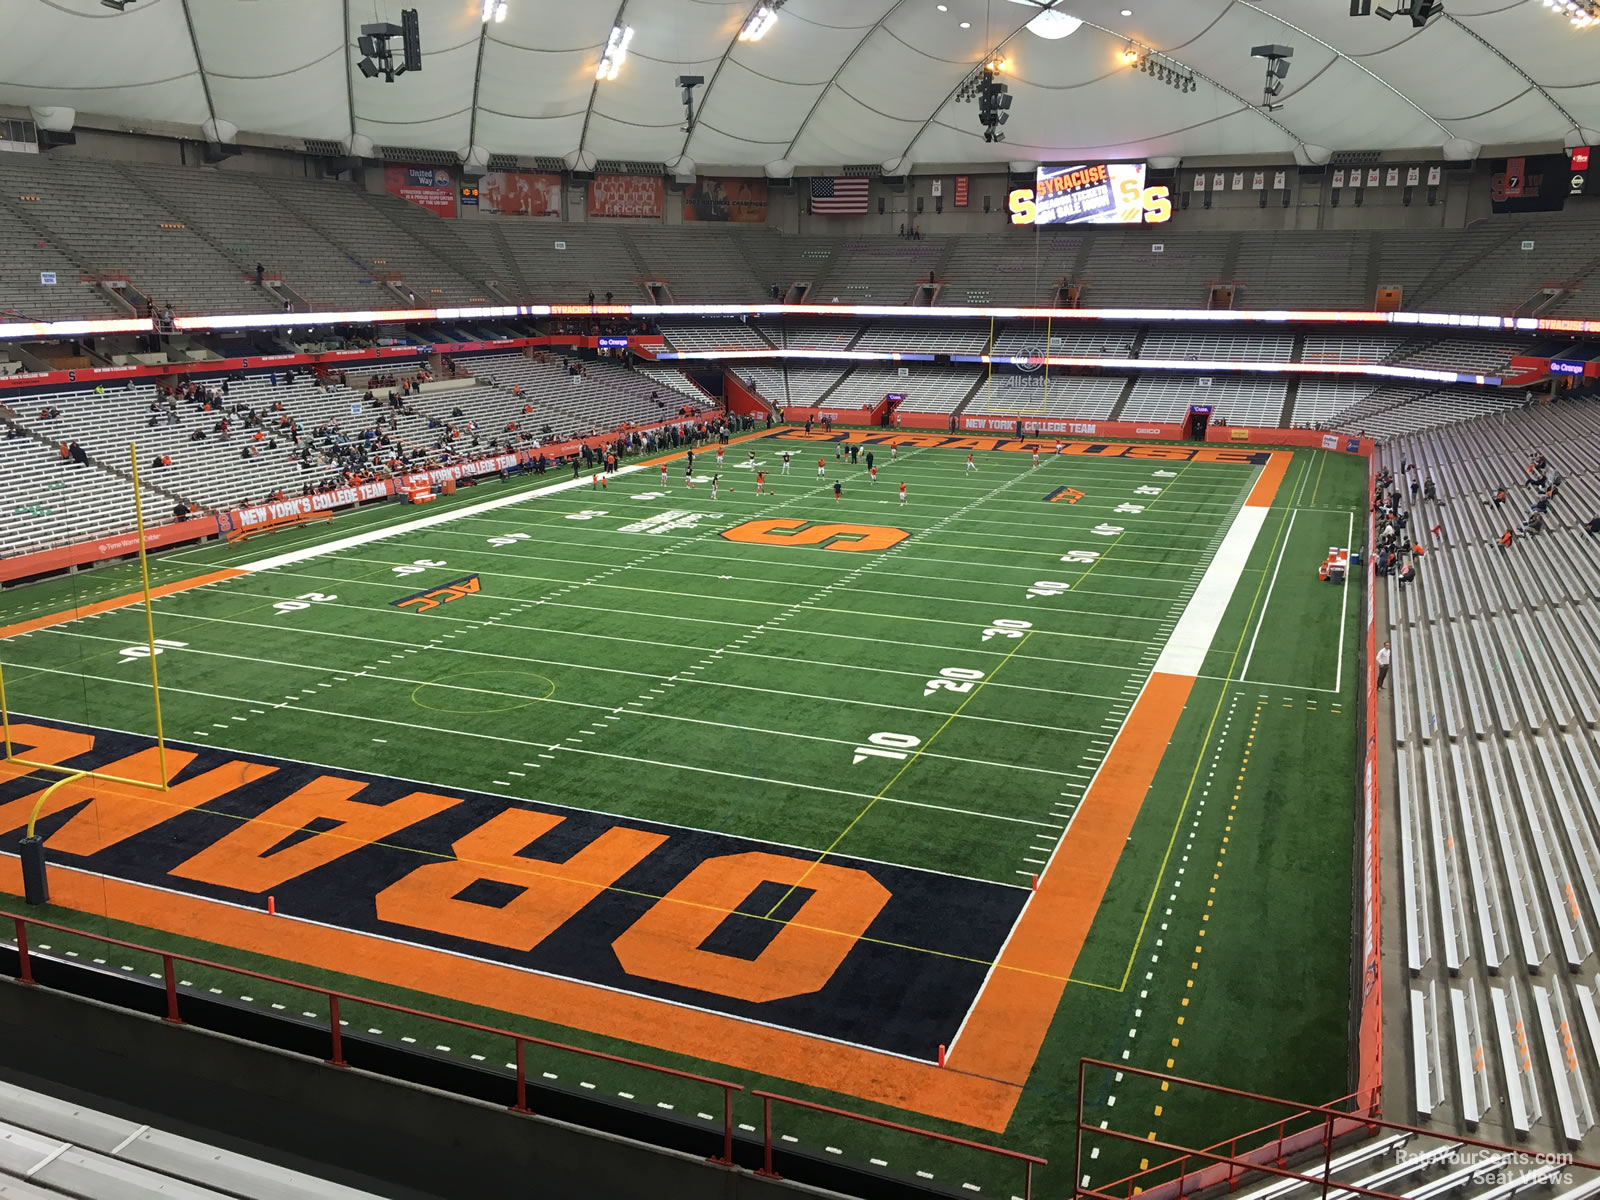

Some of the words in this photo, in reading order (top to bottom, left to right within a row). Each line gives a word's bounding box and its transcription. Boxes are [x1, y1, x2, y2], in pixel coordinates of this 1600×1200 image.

[409, 169, 432, 177] United
[419, 177, 432, 186] Way
[1037, 164, 1107, 196] SYRACUSE
[1120, 179, 1140, 203] S
[1009, 188, 1036, 224] S
[1143, 186, 1171, 223] S
[552, 305, 592, 314] SYRACUSE
[593, 305, 630, 314] FOOTBALL
[1539, 318, 1584, 331] SYRACUSE
[1550, 362, 1560, 371] Go
[1561, 363, 1583, 374] Orange
[1006, 375, 1050, 387] Allstate
[965, 418, 986, 429] NEW
[1024, 421, 1067, 432] COLLEGE
[1069, 423, 1096, 434] TEAM
[430, 466, 462, 484] YORK'S
[462, 459, 496, 477] COLLEGE
[496, 454, 517, 470] TEAM
[239, 507, 267, 527] NEW
[269, 498, 312, 519] YORK'S
[313, 488, 359, 510] COLLEGE
[359, 482, 387, 501] TEAM
[217, 513, 231, 532] S
[107, 540, 121, 550] Time
[121, 537, 141, 548] Warne
[720, 518, 912, 552] S
[1060, 550, 1100, 563] 50
[392, 559, 448, 574] 30
[397, 576, 482, 613] ACC
[1028, 580, 1070, 596] 40
[273, 593, 338, 612] 20
[987, 618, 1033, 638] 30
[120, 639, 190, 660] 10
[926, 667, 986, 693] 20
[853, 731, 922, 760] 10
